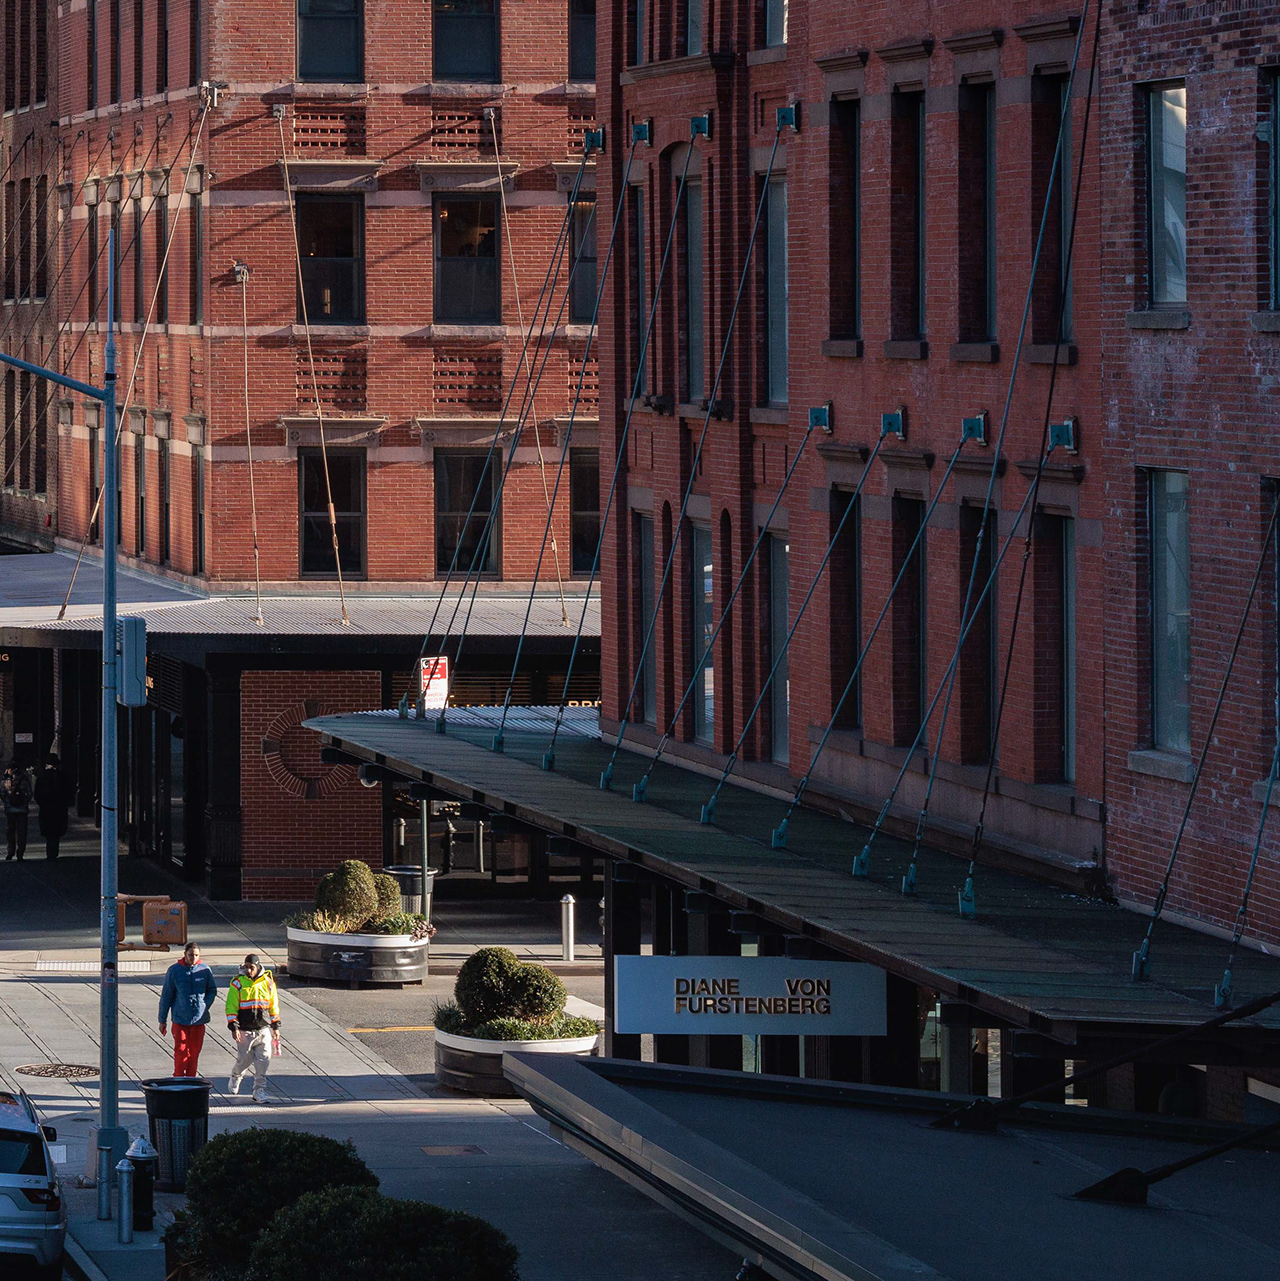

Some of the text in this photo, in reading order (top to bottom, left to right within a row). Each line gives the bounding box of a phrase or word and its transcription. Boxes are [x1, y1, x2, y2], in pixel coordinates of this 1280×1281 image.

[674, 978, 831, 996] DIANE VON
[674, 997, 831, 1015] FURSTENBERG
